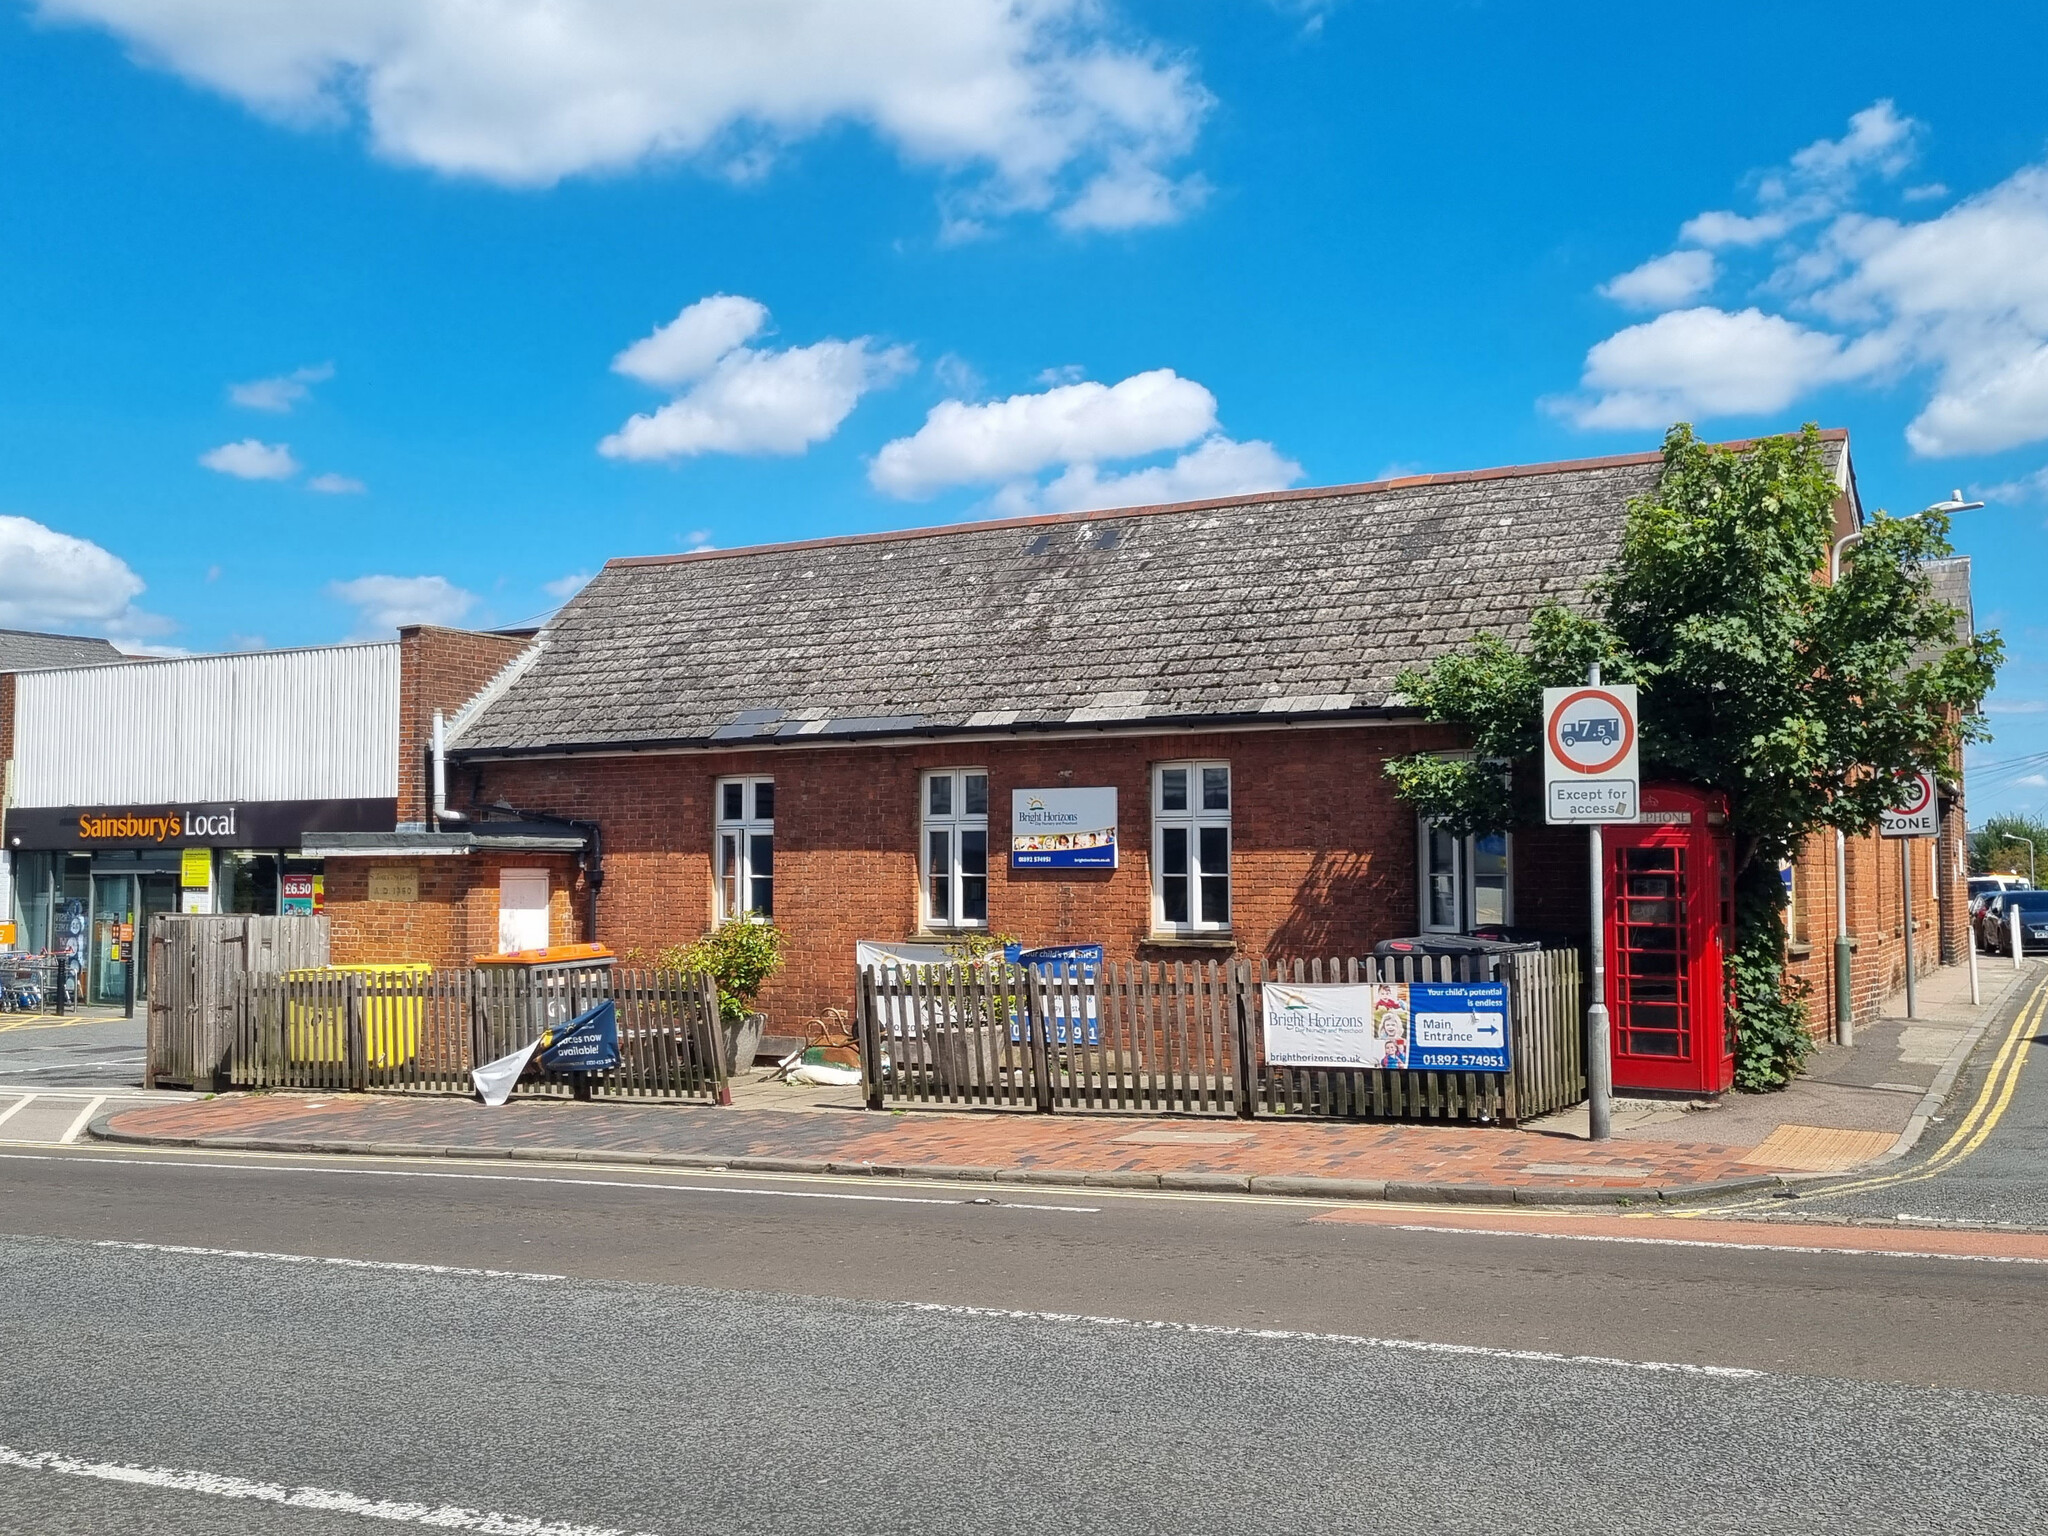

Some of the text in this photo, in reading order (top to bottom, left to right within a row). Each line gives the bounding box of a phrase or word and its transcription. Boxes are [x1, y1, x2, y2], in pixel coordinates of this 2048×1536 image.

[1558, 789, 1627, 802] Except for
[1570, 804, 1615, 815] access
[1019, 811, 1078, 824] Bright Horizons
[79, 807, 236, 843] Sainsbury's Local
[1886, 817, 1931, 830] ZONE
[285, 883, 311, 895] £6.50
[1427, 988, 1502, 998] Your child's potential
[1467, 999, 1503, 1007] is endless
[1269, 1012, 1363, 1030] Bright Horizons
[1423, 1019, 1451, 1029] Main
[584, 1034, 602, 1042] now
[1424, 1031, 1473, 1042] Entrance
[558, 1045, 599, 1056] available!
[1270, 1052, 1361, 1063] brighthorizons.co.uk
[1423, 1055, 1505, 1067] 01892 574951
